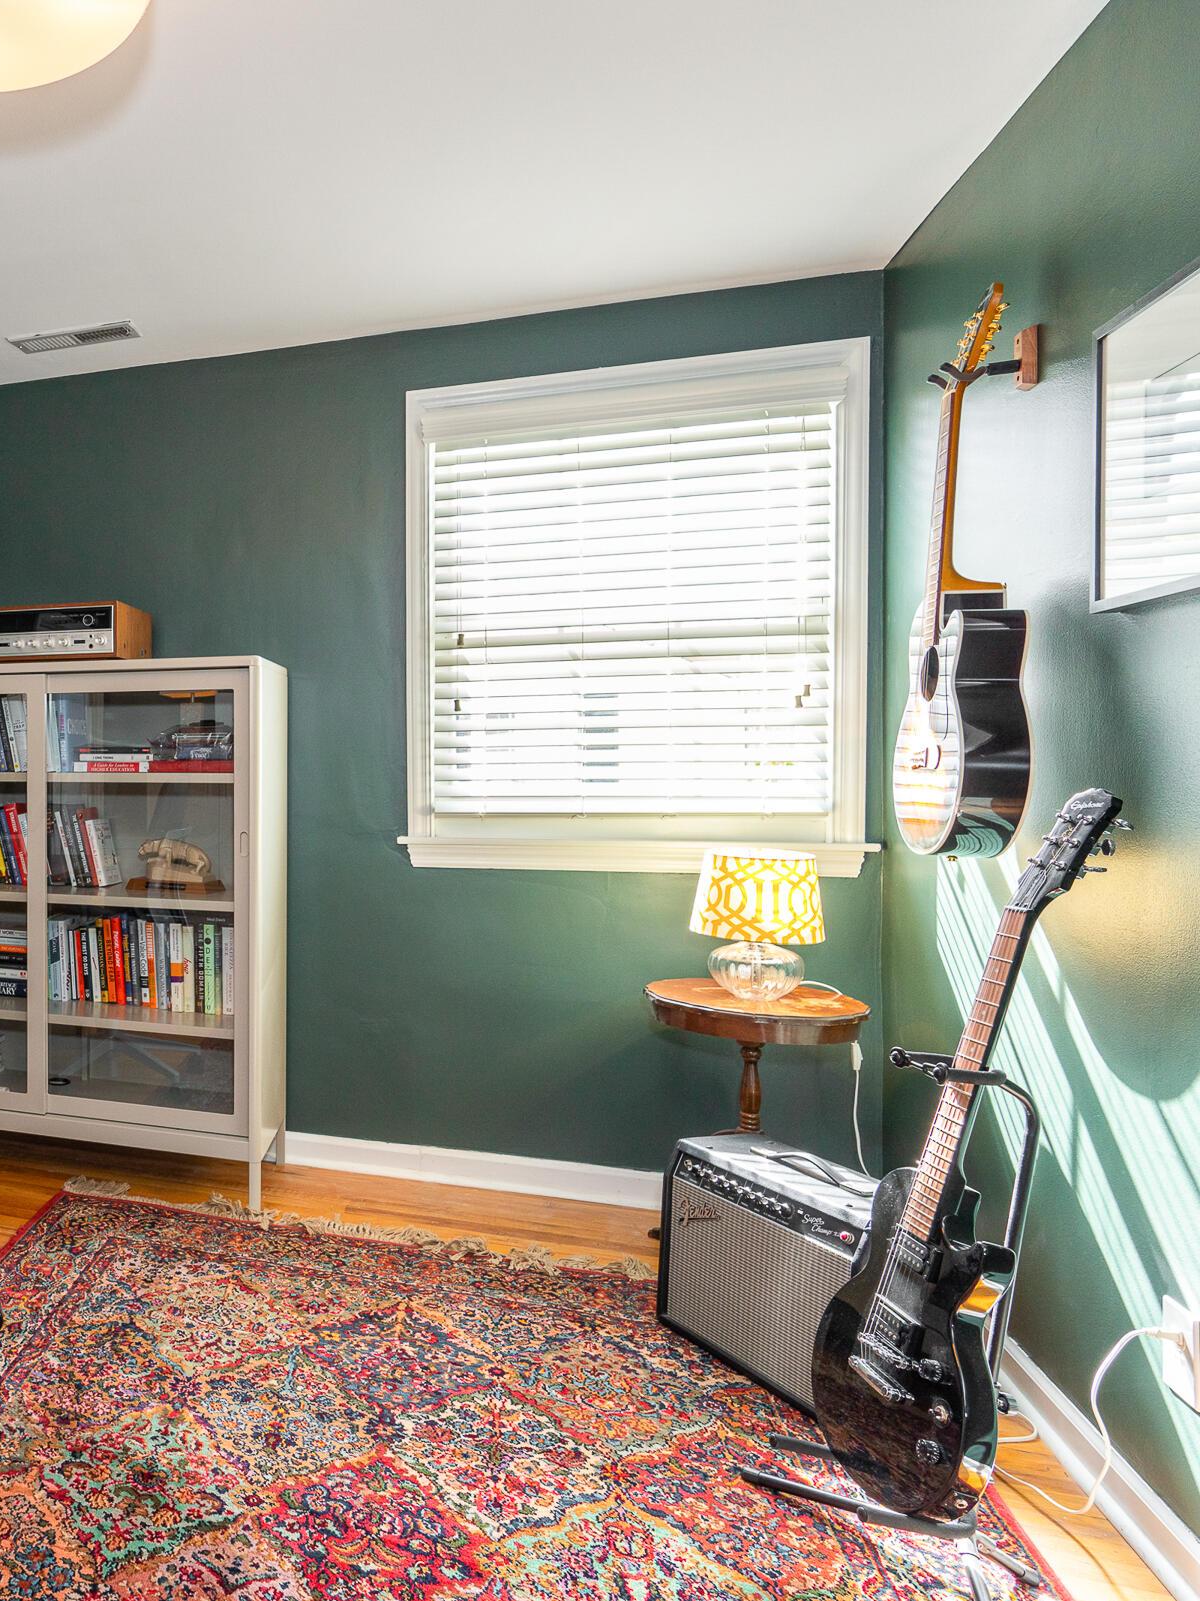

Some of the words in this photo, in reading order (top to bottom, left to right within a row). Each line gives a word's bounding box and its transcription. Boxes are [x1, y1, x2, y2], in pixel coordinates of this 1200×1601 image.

[1070, 800, 1105, 810] Epiphone
[74, 822, 84, 851] COLLABORATION
[80, 852, 89, 874] IMPERATIVE
[678, 1197, 721, 1227] Fender
[802, 1214, 824, 1225] Super
[811, 1224, 832, 1236] Champ
